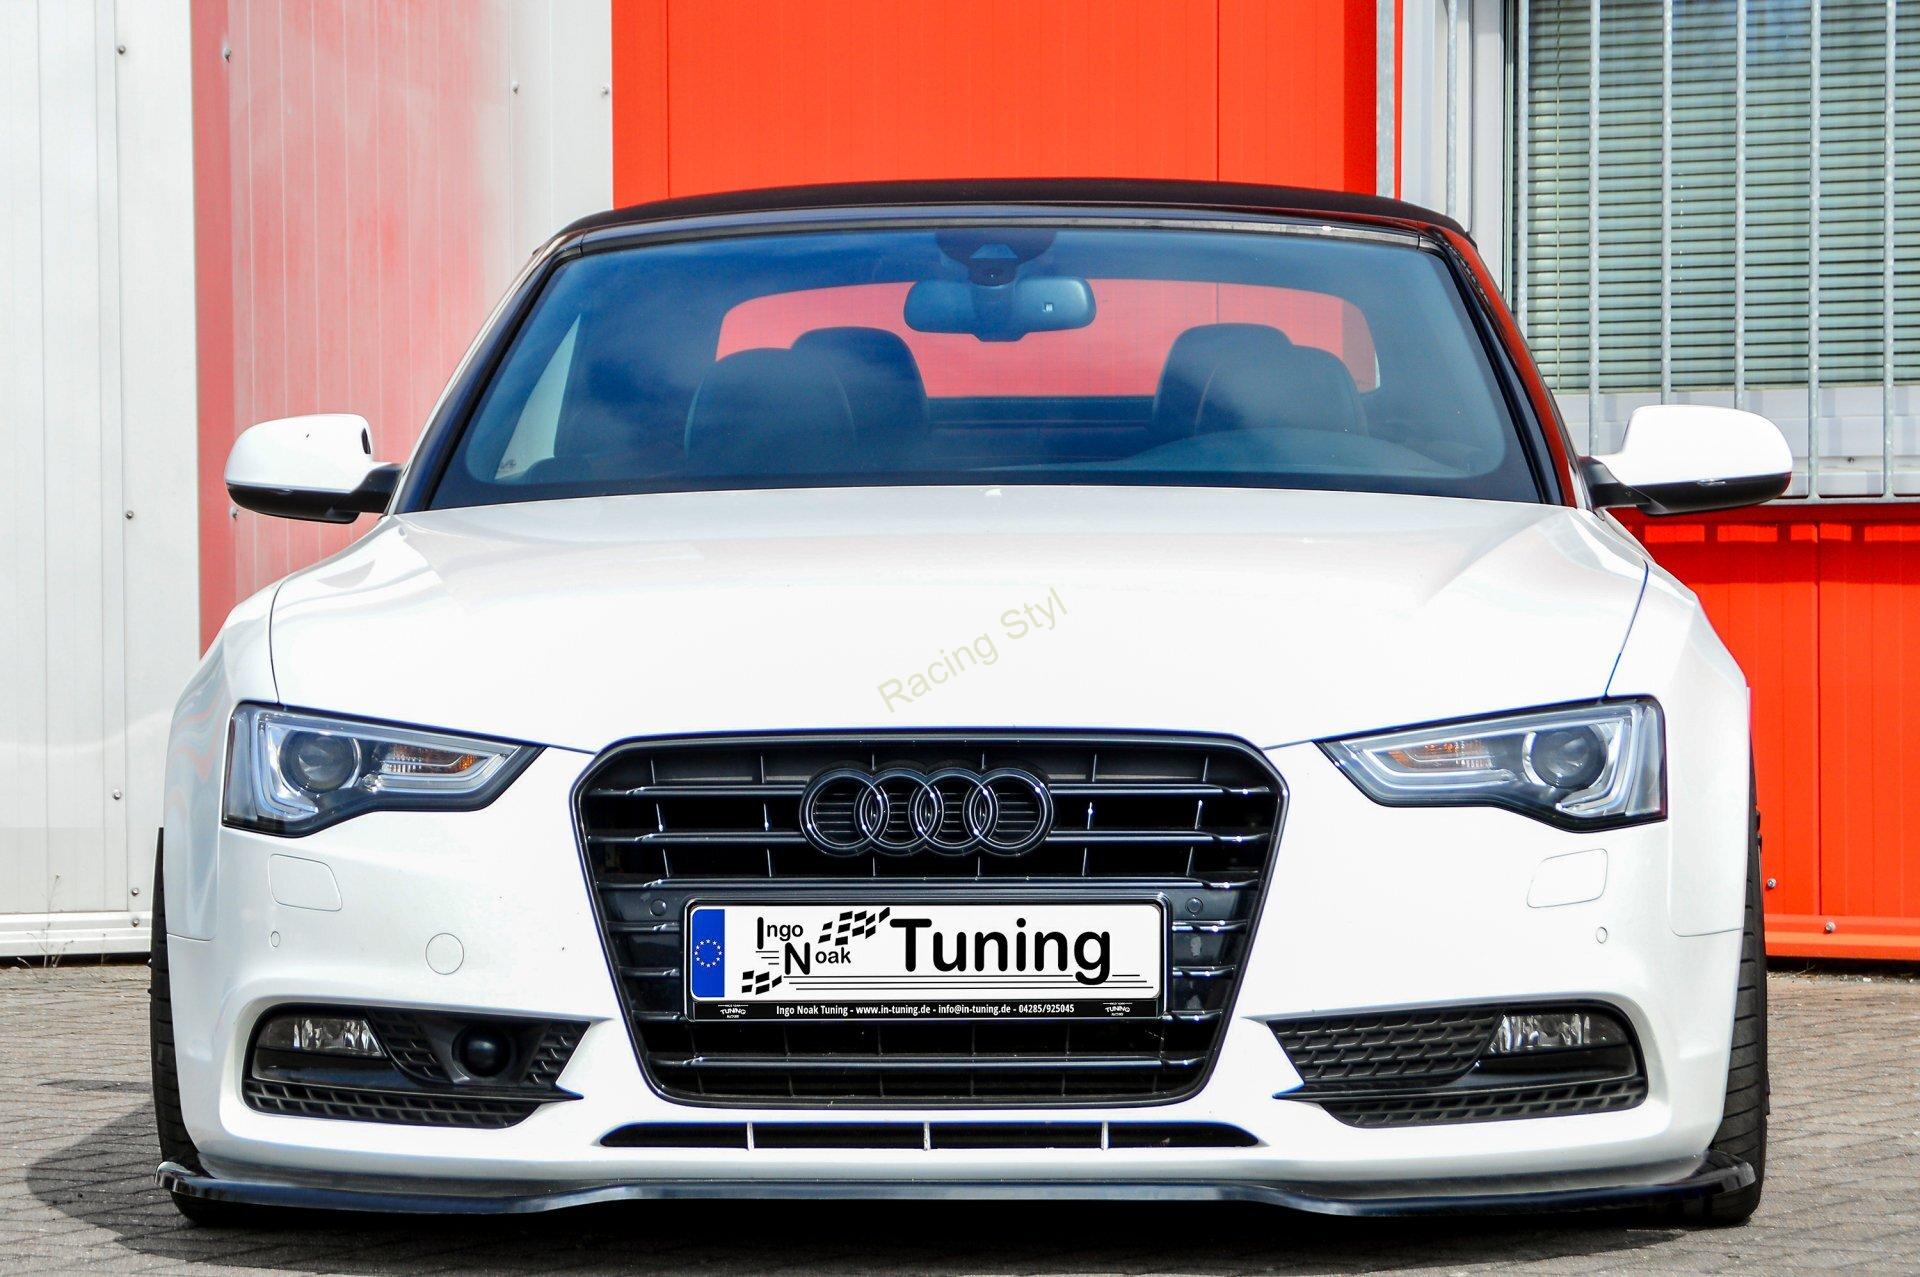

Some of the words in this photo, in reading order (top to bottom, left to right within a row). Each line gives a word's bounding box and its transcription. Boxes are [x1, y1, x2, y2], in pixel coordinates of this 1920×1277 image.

[757, 917, 804, 950] Ingo
[785, 942, 851, 976] Noak
[890, 918, 1110, 985] Tuning
[720, 1007, 747, 1015] TUNING
[776, 1005, 795, 1017] Ingo
[797, 1005, 819, 1015] Noak
[821, 1005, 849, 1017] Tuning
[855, 1004, 931, 1016] www.in-tuning.de
[938, 1004, 1011, 1016] info@in-tuning.de
[1018, 1004, 1075, 1014] 04285/925045
